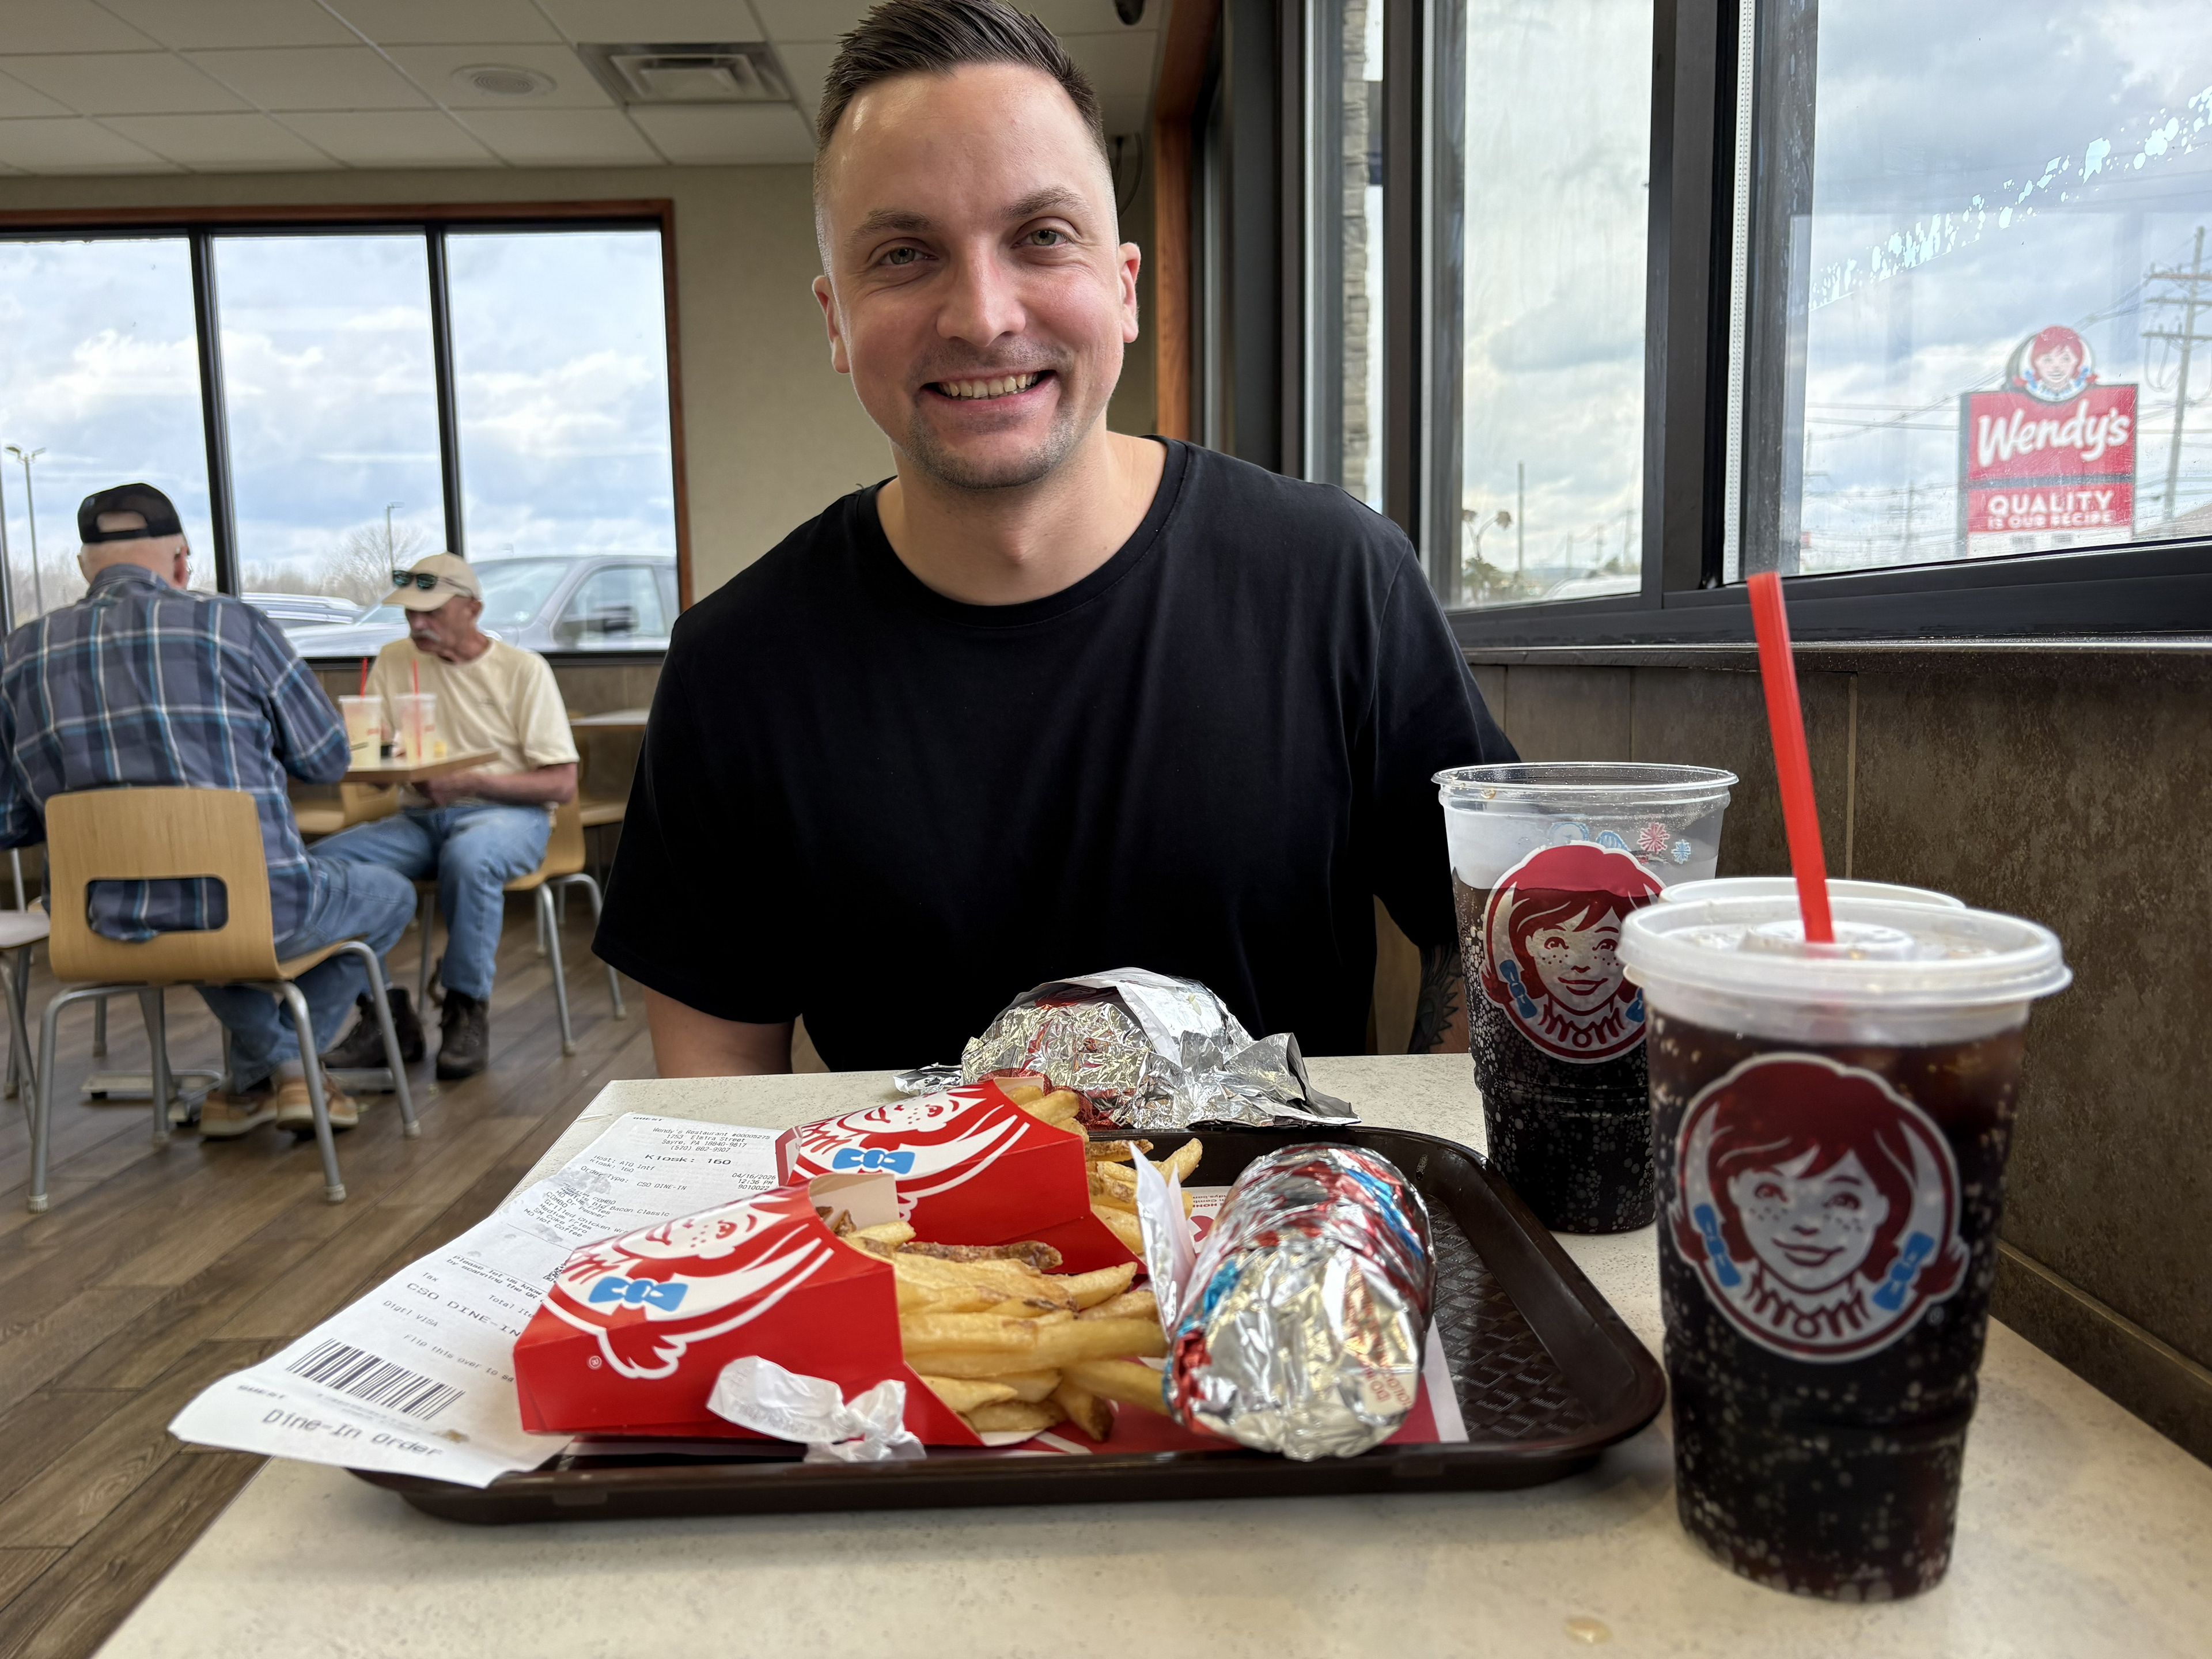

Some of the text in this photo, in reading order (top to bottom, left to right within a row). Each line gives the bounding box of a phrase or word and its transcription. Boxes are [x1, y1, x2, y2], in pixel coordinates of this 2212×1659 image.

[1978, 398, 2131, 467] Wendy's
[1988, 490, 2115, 516] QUALITY
[589, 1158, 616, 1169] Kiosk:
[593, 1154, 616, 1164] Host:
[644, 1154, 695, 1163] Kiosk:
[580, 1165, 604, 1177] Order
[607, 1173, 629, 1184] Type:
[654, 1182, 688, 1191] DINE-IN
[732, 1172, 777, 1180] 04/16/2026
[546, 1191, 569, 1208] COMBO
[555, 1190, 566, 1198] MD
[578, 1206, 607, 1218] Pepper
[592, 1196, 616, 1205] COMBO
[524, 1208, 583, 1237] MD Hot Coffee
[533, 1207, 588, 1234] SM Coke Zero
[539, 1203, 592, 1230] Medium Fries
[544, 1199, 577, 1218] Grilled
[578, 1217, 611, 1230] Chicken
[637, 1209, 670, 1217] Classic
[446, 1258, 459, 1266] by
[521, 1283, 543, 1296] know
[406, 1282, 522, 1338] CSO DINE-IN
[488, 1294, 516, 1309] Total
[415, 1313, 439, 1328] VISA
[403, 1333, 428, 1347] Flip
[431, 1345, 455, 1359] this
[457, 1357, 483, 1369] over
[485, 1366, 499, 1376] to
[261, 1408, 364, 1440] Dine-In
[369, 1431, 445, 1457] Order
